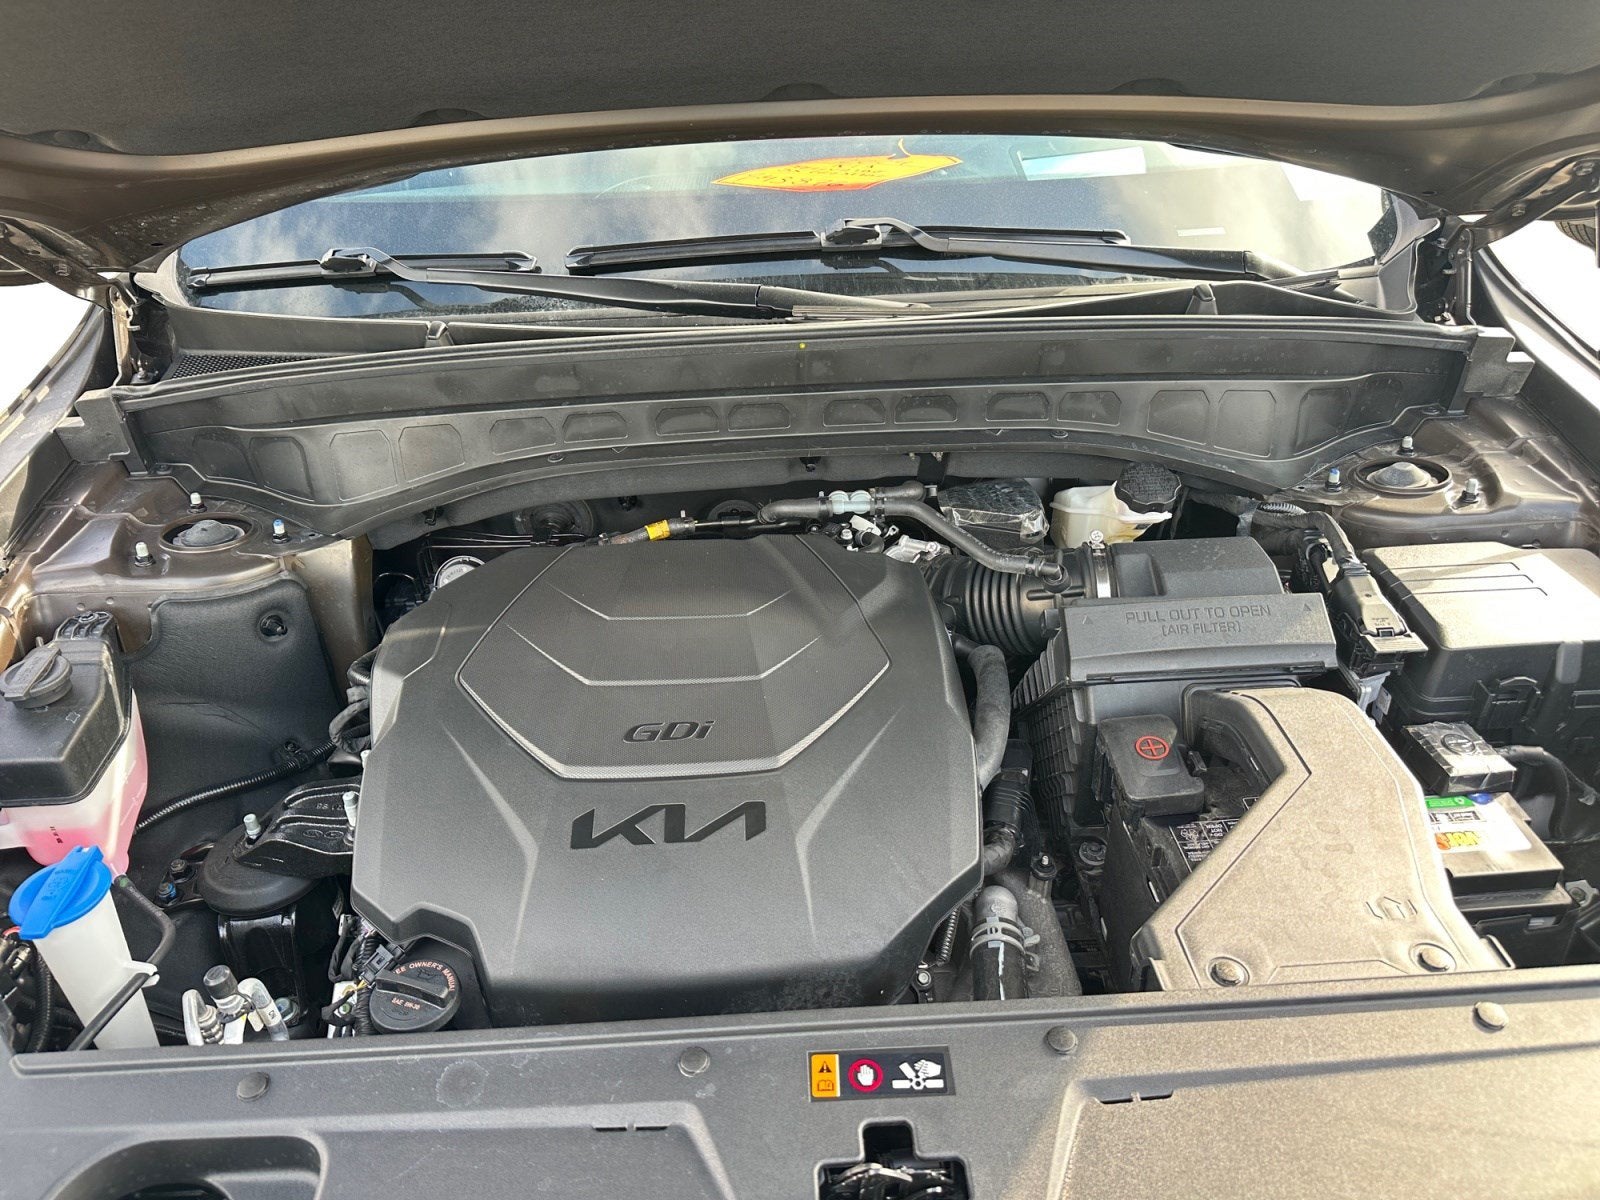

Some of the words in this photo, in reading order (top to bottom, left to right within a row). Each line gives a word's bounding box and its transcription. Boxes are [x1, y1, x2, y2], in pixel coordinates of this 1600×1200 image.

[1125, 609, 1166, 624] PULL
[1169, 608, 1200, 621] OUT
[1204, 606, 1225, 619] TO
[1229, 604, 1271, 618] OPEN
[622, 720, 716, 744] GDi
[570, 800, 767, 850] KIA
[393, 965, 407, 975] EE
[408, 961, 444, 971] OWNER'S
[441, 967, 456, 993] MANUAL
